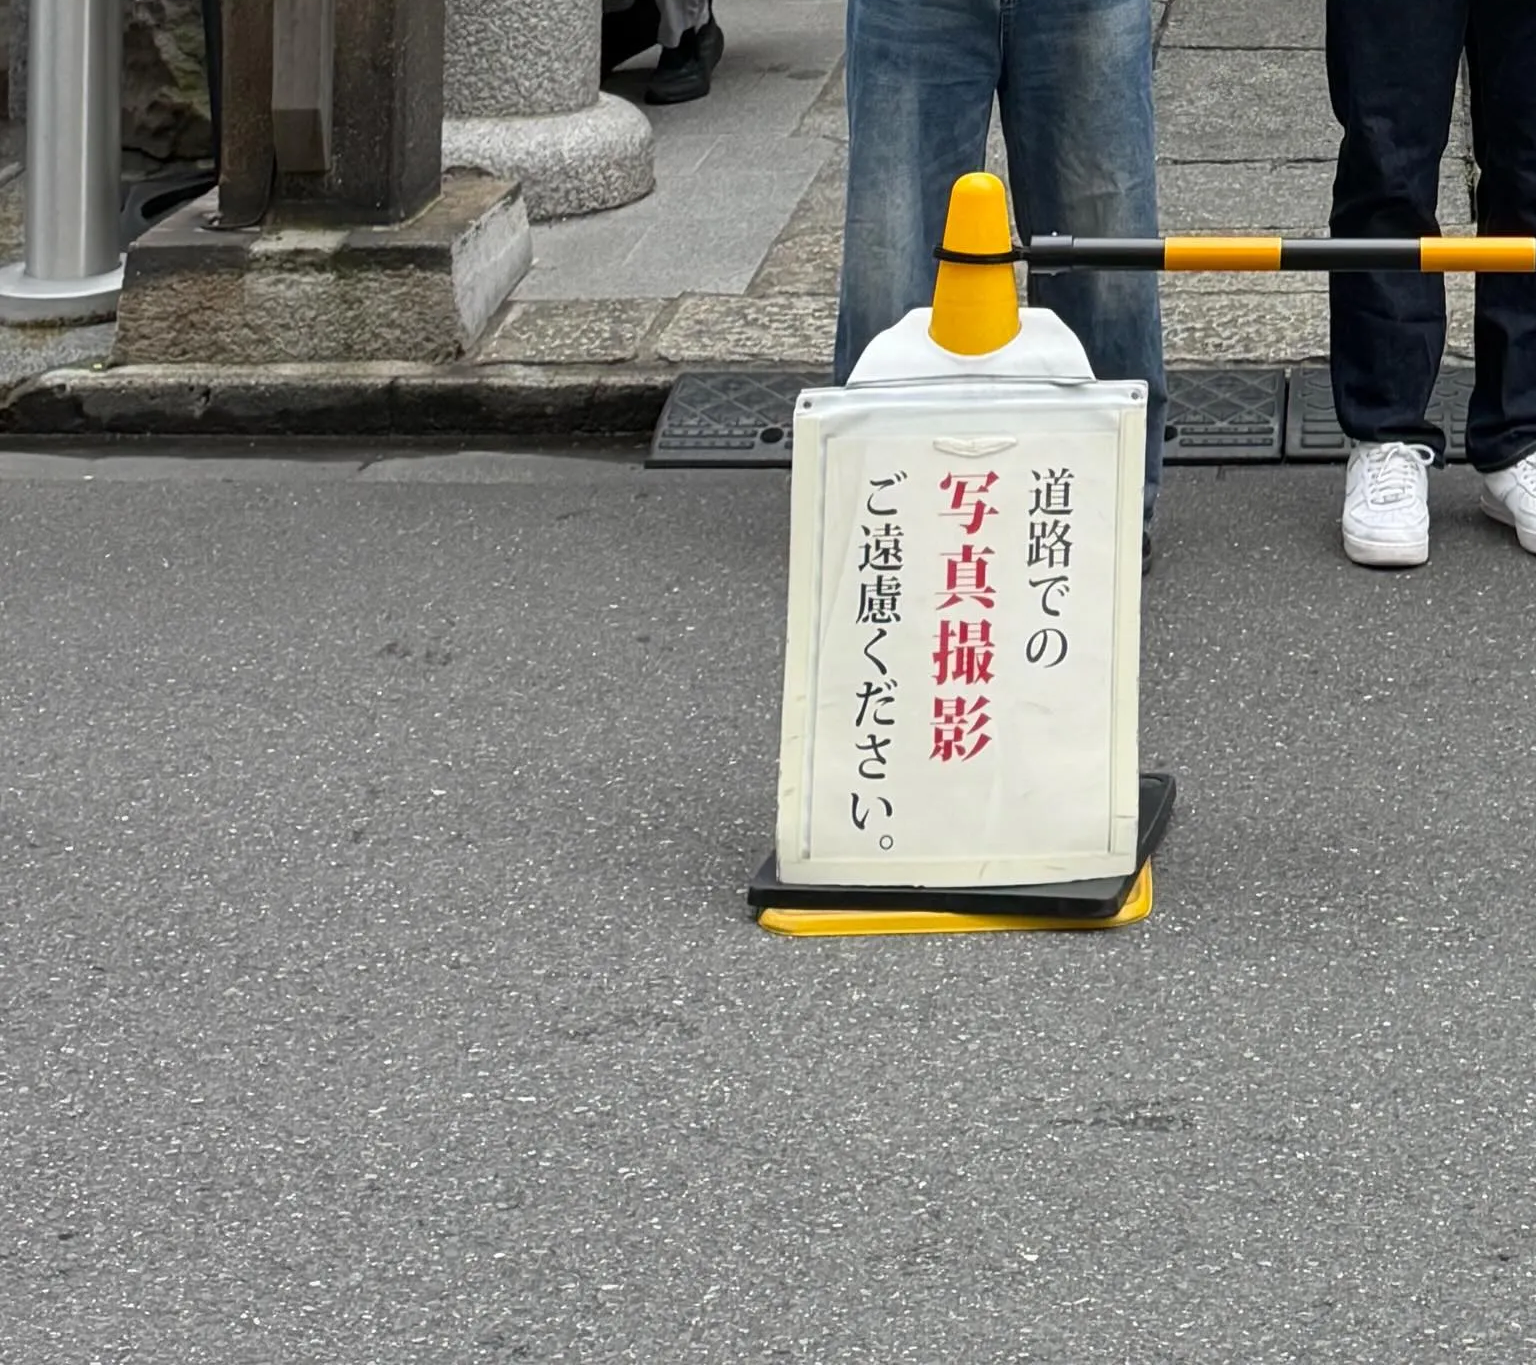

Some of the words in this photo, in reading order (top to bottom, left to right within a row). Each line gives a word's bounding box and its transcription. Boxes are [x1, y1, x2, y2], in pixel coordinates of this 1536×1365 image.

[850, 469, 907, 852] ご遠慮ください。
[928, 469, 1000, 764] 写真撮影
[1024, 466, 1074, 670] 道路での
